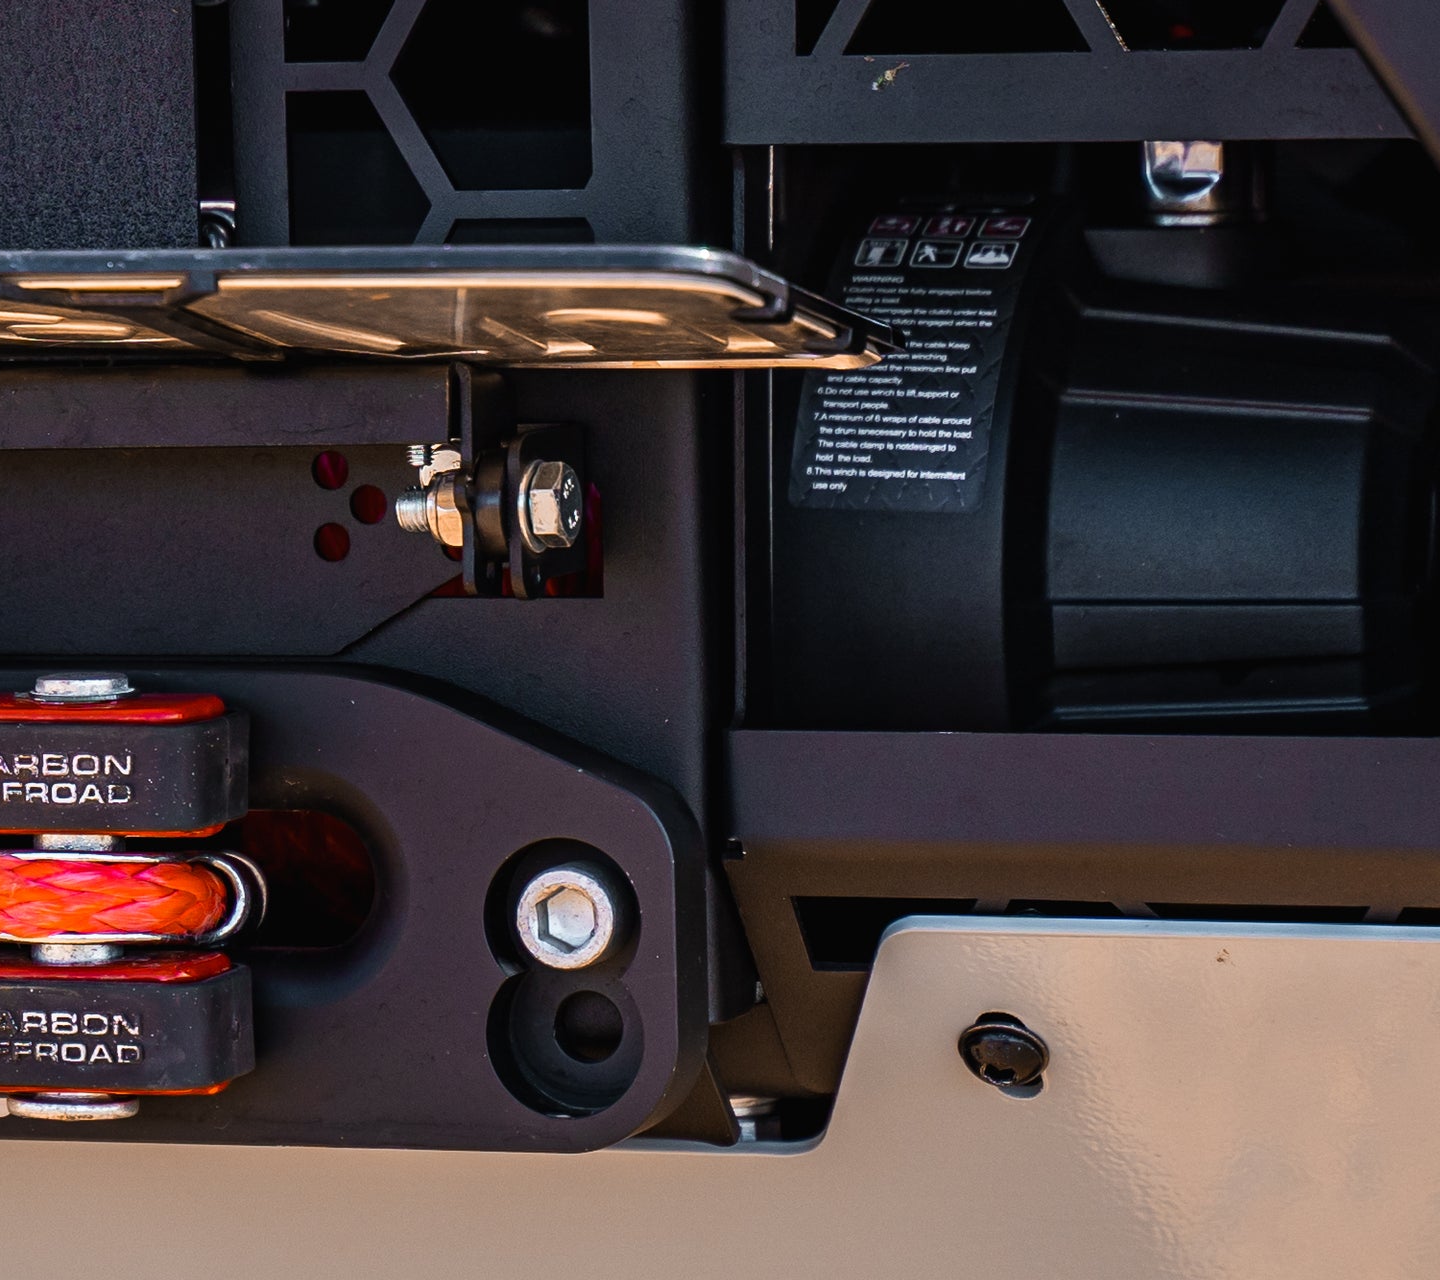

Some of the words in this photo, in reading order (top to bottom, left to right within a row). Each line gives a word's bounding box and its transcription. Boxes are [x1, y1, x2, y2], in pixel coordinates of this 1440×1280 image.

[851, 275, 904, 284] WARNING
[876, 286, 897, 294] must
[898, 286, 909, 294] be
[910, 287, 926, 296] fully
[928, 288, 964, 296] engaged
[965, 288, 992, 296] before
[845, 297, 872, 305] pulling
[928, 308, 952, 316] clutch
[953, 309, 977, 317] under
[917, 320, 954, 328] engaged
[909, 341, 922, 349] the
[903, 365, 944, 373] maximum
[961, 366, 977, 375] pull
[827, 375, 843, 383] and
[844, 375, 867, 383] cable
[838, 387, 852, 395] not
[871, 388, 895, 397] winch
[896, 389, 905, 397] to
[950, 391, 960, 399] or
[823, 400, 859, 409] transport
[864, 414, 874, 423] of
[882, 415, 907, 425] wraps
[908, 415, 918, 424] of
[918, 416, 941, 425] cable
[942, 416, 972, 426] around
[819, 426, 833, 434] the
[834, 426, 856, 435] drum
[908, 429, 917, 438] to
[918, 429, 937, 438] hold
[938, 430, 951, 439] the
[953, 431, 973, 440] load.
[818, 439, 834, 448] The
[835, 440, 858, 449] cable
[859, 441, 885, 451] clamp
[886, 442, 894, 450] is
[948, 444, 957, 452] to
[815, 453, 833, 462] hold
[838, 454, 851, 463] the
[852, 454, 873, 463] load.
[833, 468, 857, 477] winch
[858, 468, 866, 477] is
[867, 469, 906, 480] designed
[907, 469, 919, 479] for
[919, 471, 966, 481] intermittent
[812, 482, 828, 490] use
[829, 482, 848, 493] only
